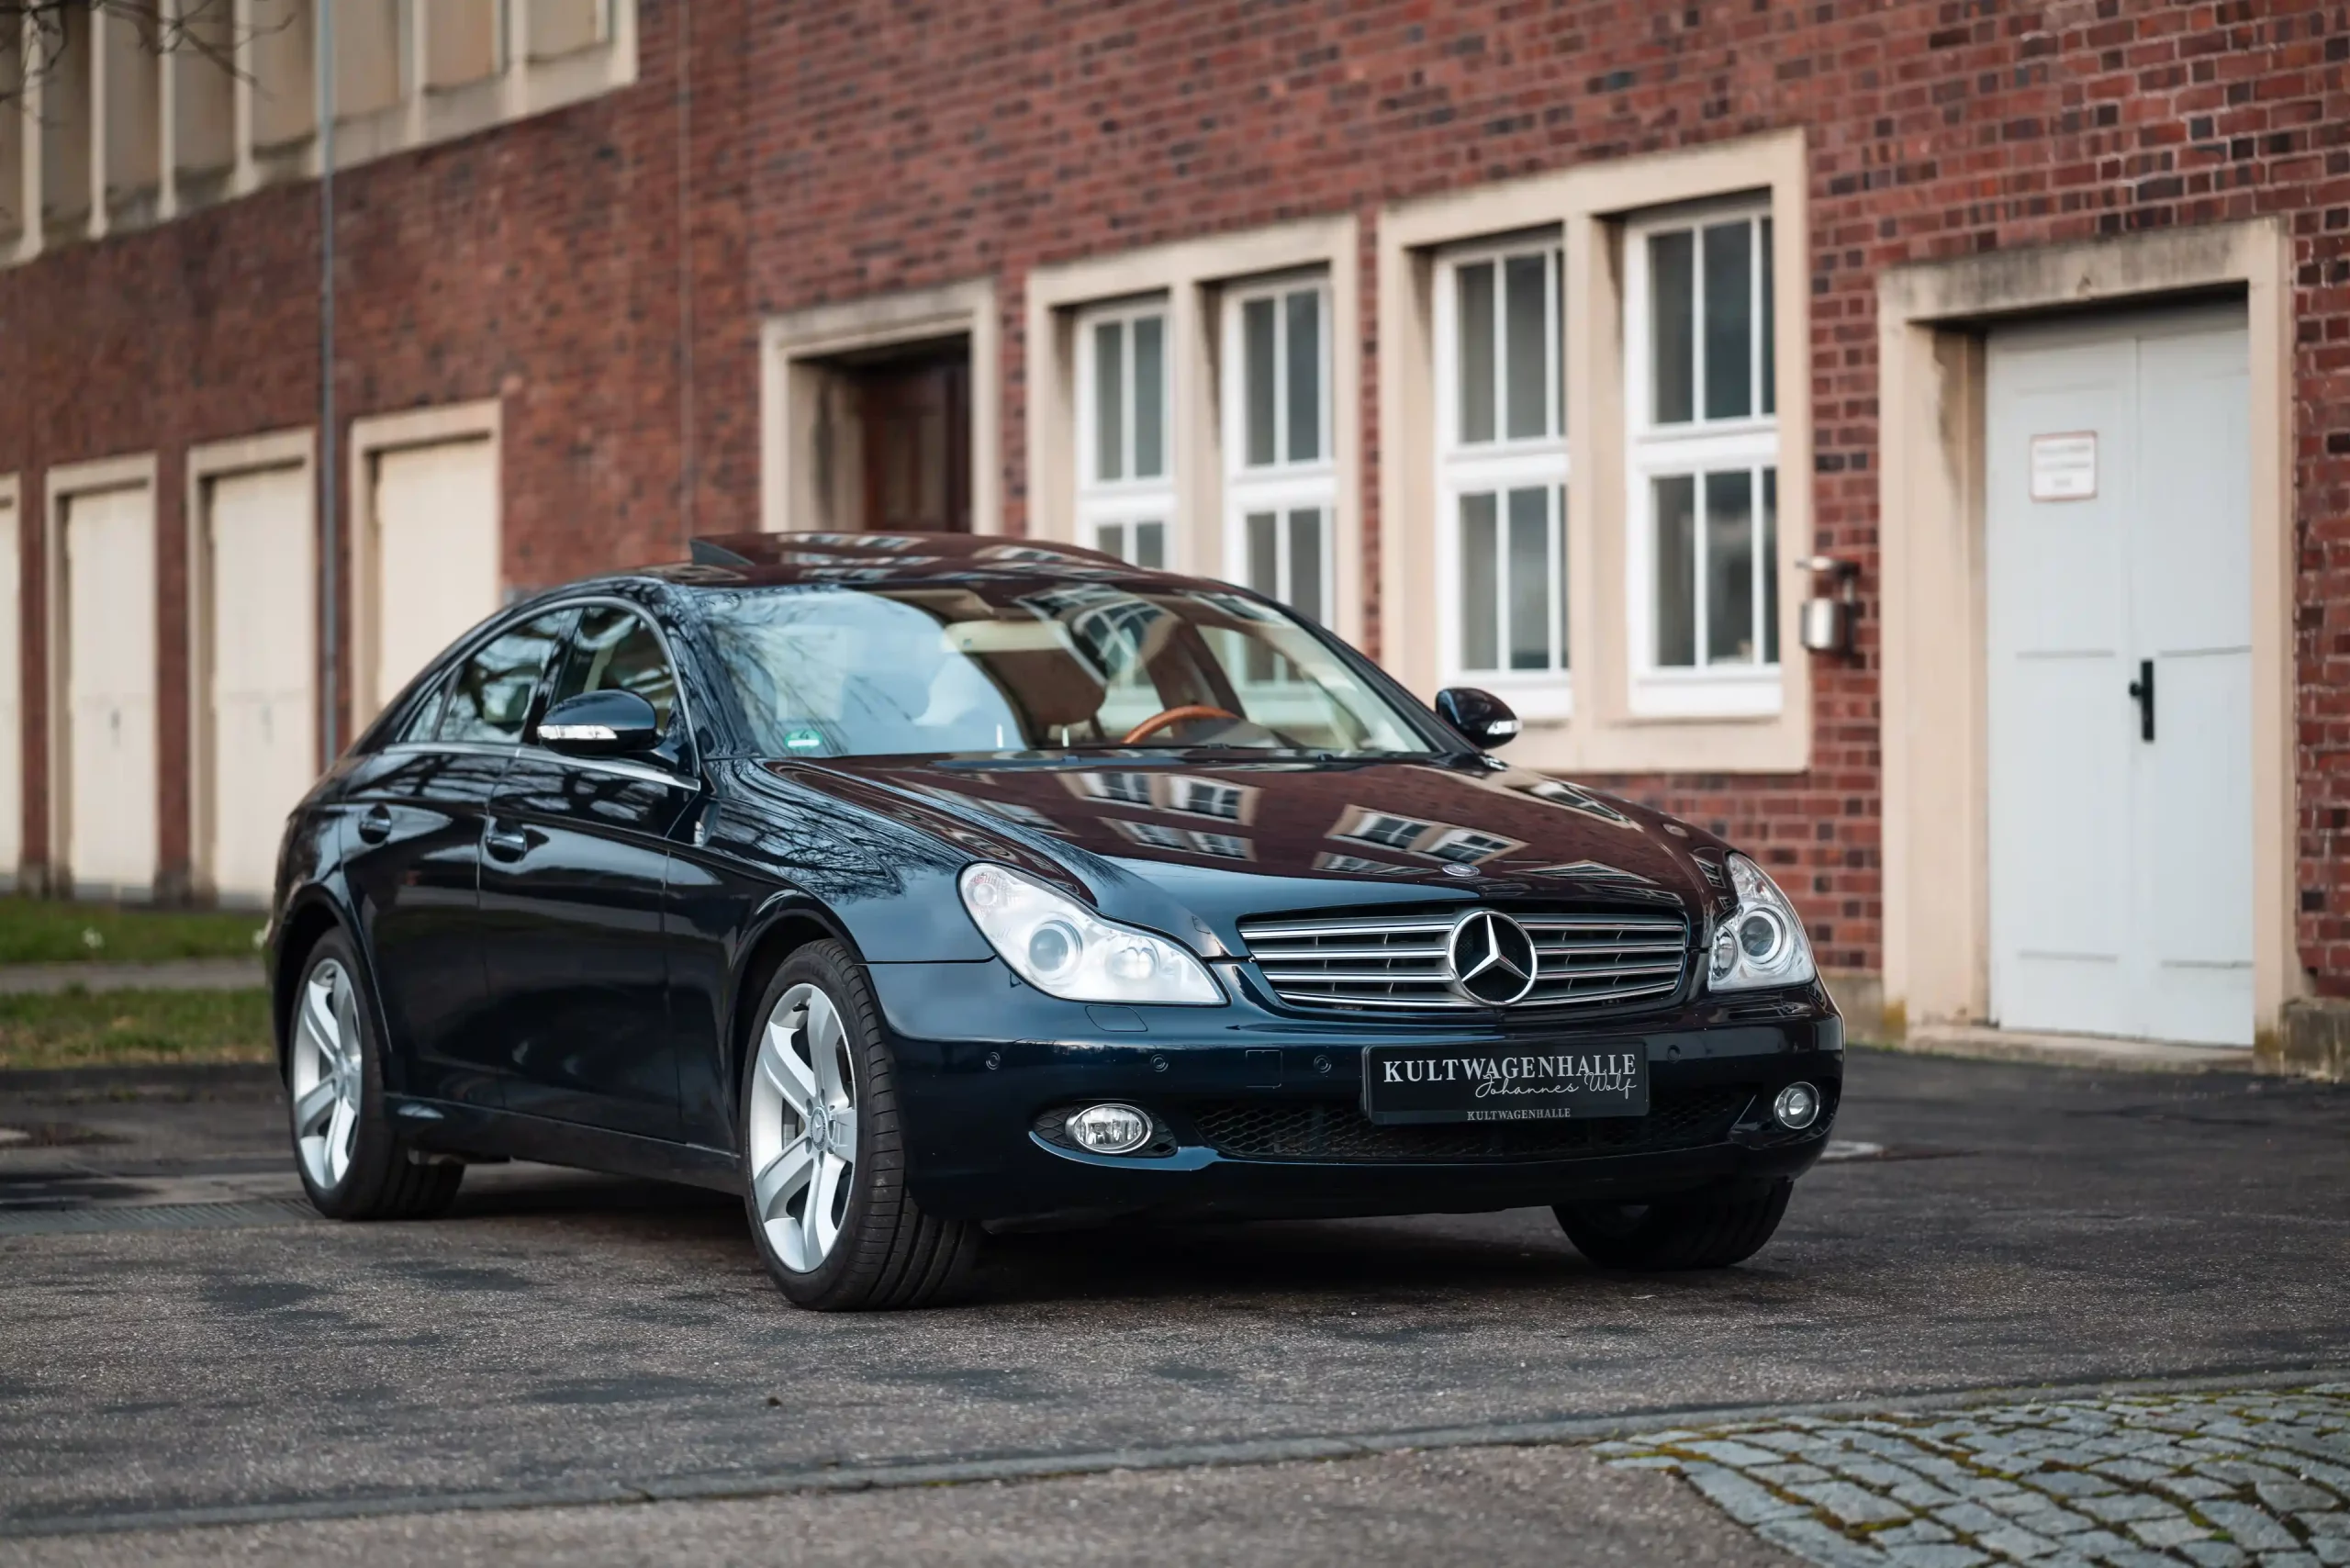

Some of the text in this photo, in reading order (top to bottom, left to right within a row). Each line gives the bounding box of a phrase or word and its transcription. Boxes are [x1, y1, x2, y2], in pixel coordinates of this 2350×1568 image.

[1383, 1054, 1636, 1082] KULTWAGENHALLE
[1475, 1069, 1638, 1100] Johannes Wolf
[1467, 1108, 1571, 1121] KULTWAGENHALLE
